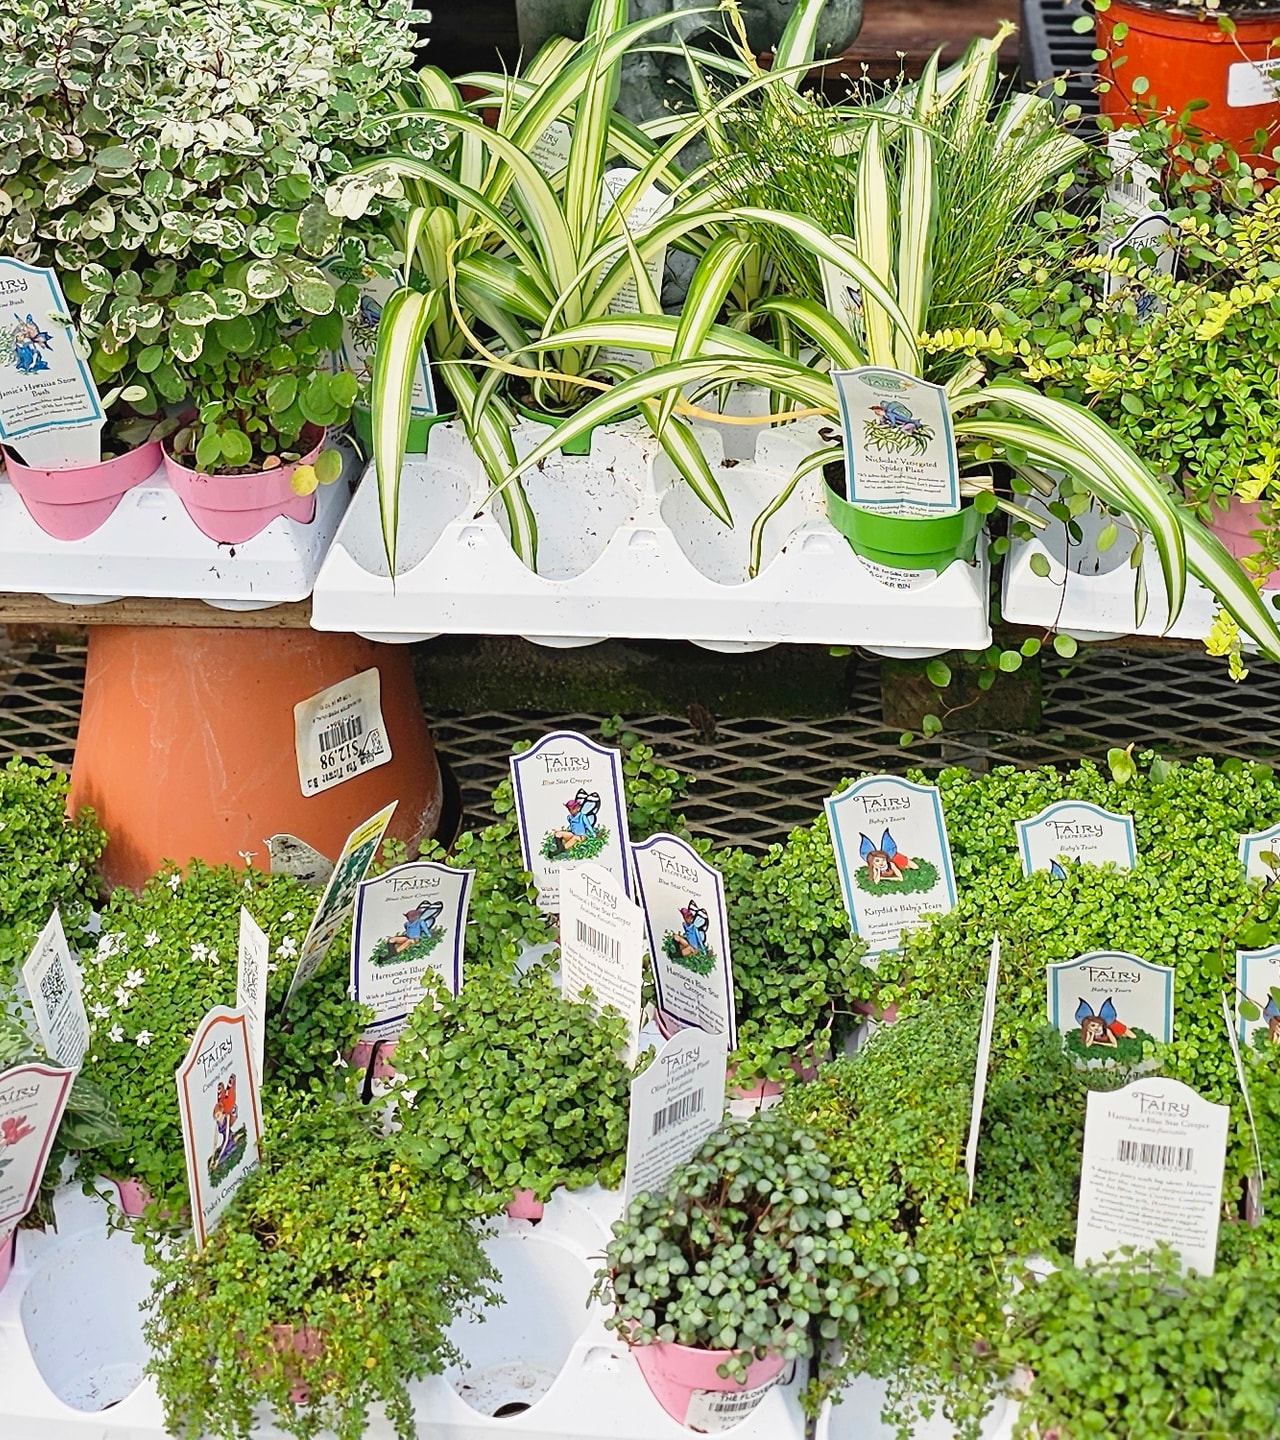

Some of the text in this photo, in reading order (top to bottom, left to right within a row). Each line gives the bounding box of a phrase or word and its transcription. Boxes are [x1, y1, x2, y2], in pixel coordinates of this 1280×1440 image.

[57, 377, 77, 385] Snow
[880, 465, 903, 473] Spider
[320, 740, 359, 769] $12.98
[536, 751, 590, 773] FAIRY
[853, 794, 911, 814] FAIRY
[1045, 820, 1103, 839] FAIRY
[650, 849, 699, 884] FAIRY
[385, 875, 441, 892] FAIRY
[581, 873, 618, 909] FAIRY
[900, 903, 922, 913] Baby's
[371, 968, 408, 982] Harrison's
[409, 965, 426, 975] Blue
[1079, 966, 1141, 983] FAIRY
[197, 1035, 233, 1078] FAIRY
[661, 1046, 701, 1077] FAIRY
[1132, 1091, 1190, 1117] FAIRY
[1146, 1116, 1162, 1125] Blue
[1165, 1117, 1179, 1127] Star
[1181, 1119, 1210, 1129] Creeper
